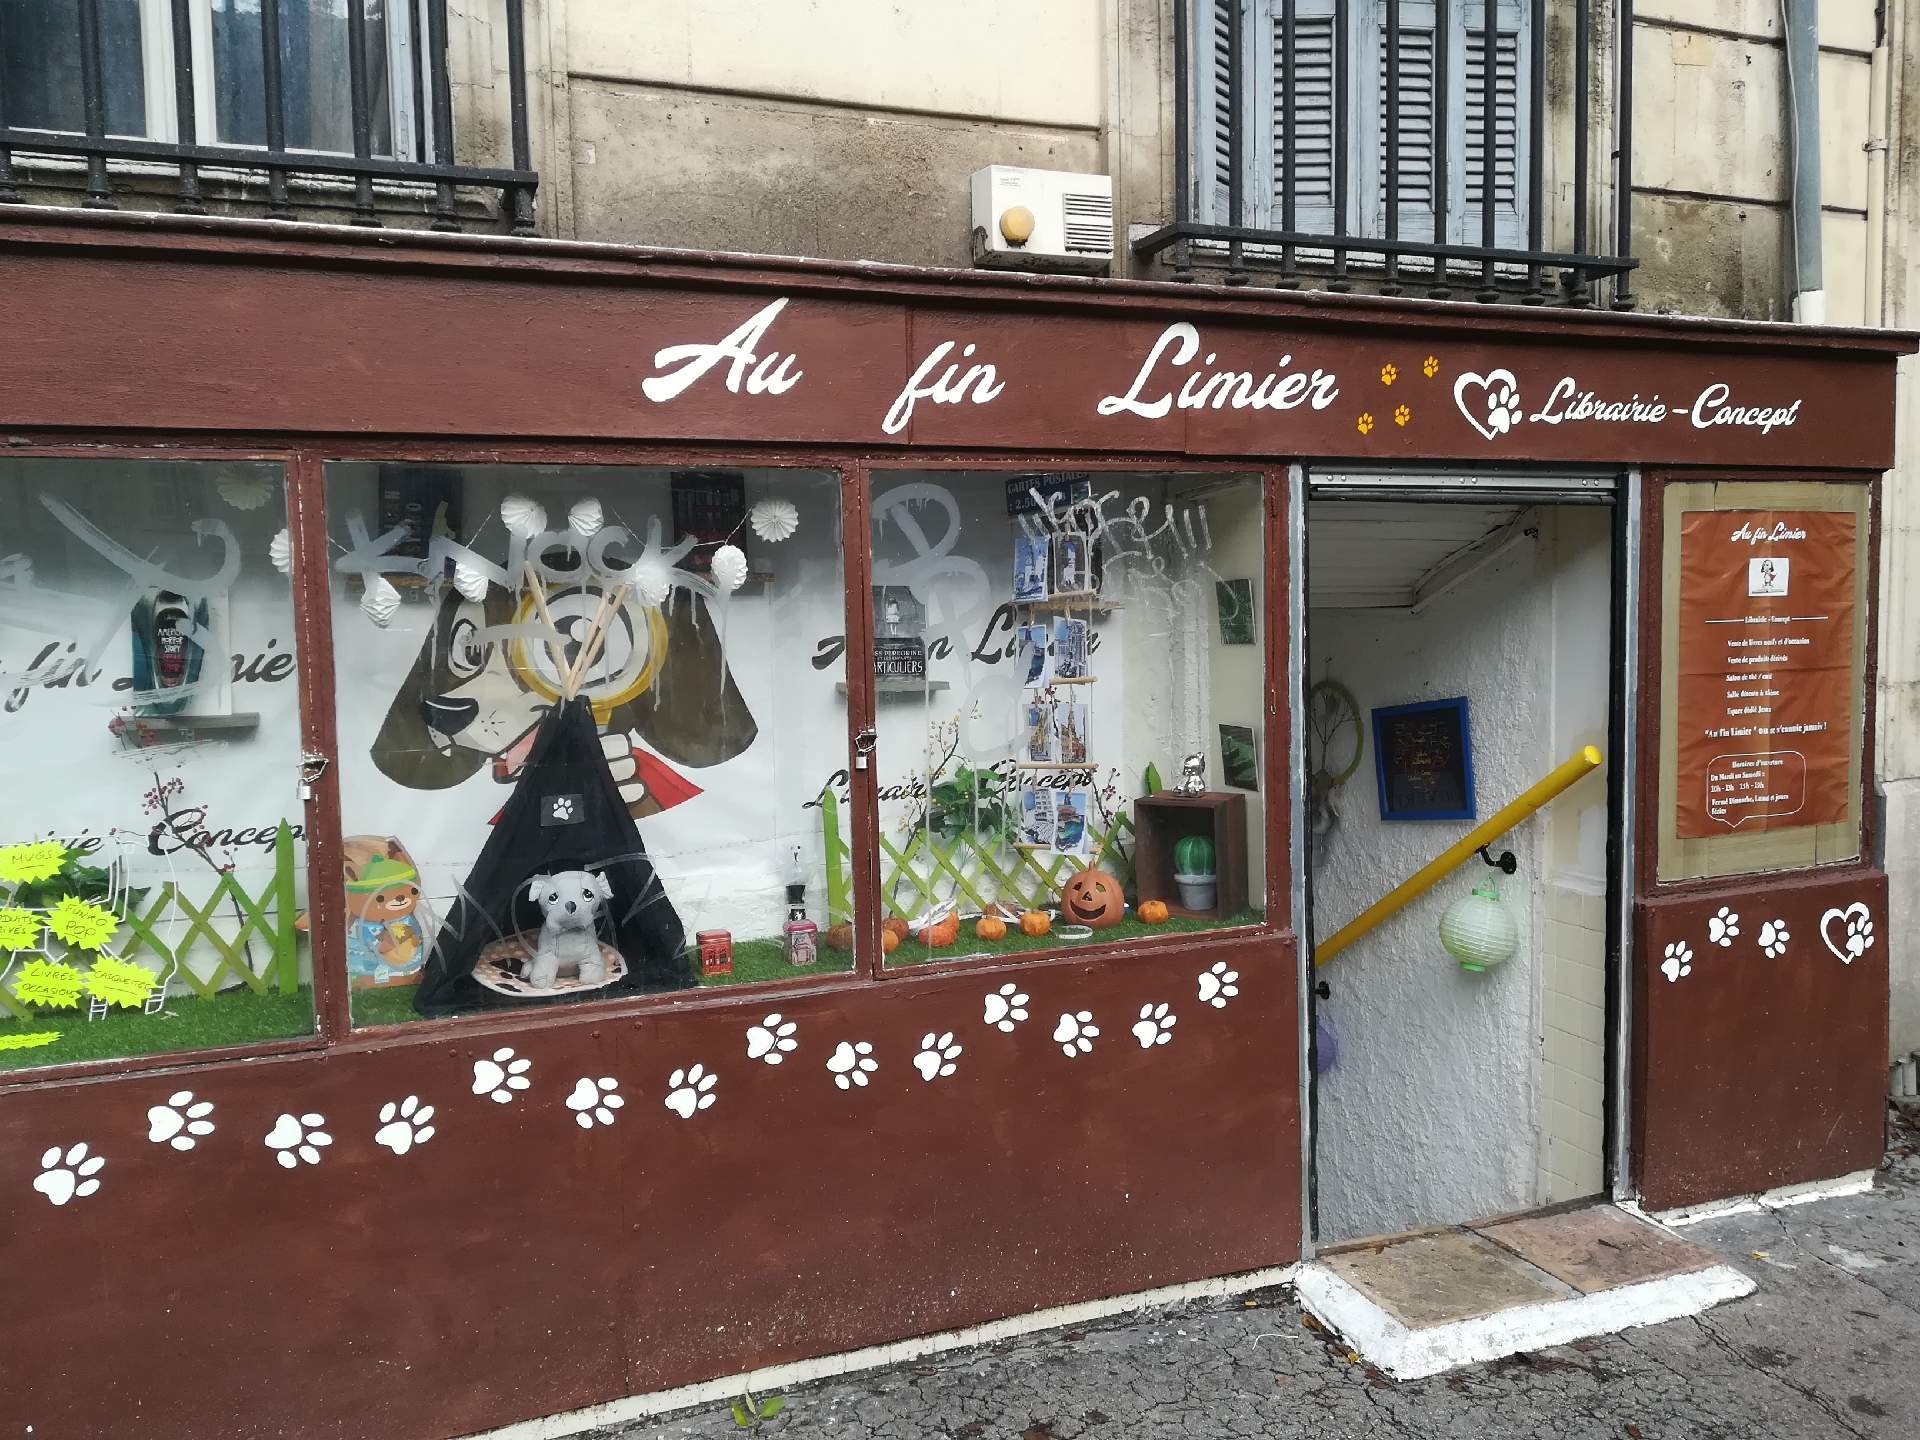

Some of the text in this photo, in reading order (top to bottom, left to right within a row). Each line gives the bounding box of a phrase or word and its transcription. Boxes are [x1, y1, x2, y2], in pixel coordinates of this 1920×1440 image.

[641, 297, 1339, 435] Au fin Limier
[1529, 376, 1667, 425] Librairie
[1691, 383, 1802, 435] Concept
[1731, 521, 1807, 546] Au fin Limier
[873, 660, 923, 674] ARTICULIERS
[11, 850, 53, 864] MUGS
[66, 920, 97, 937] POP
[31, 967, 75, 981] LIVRES
